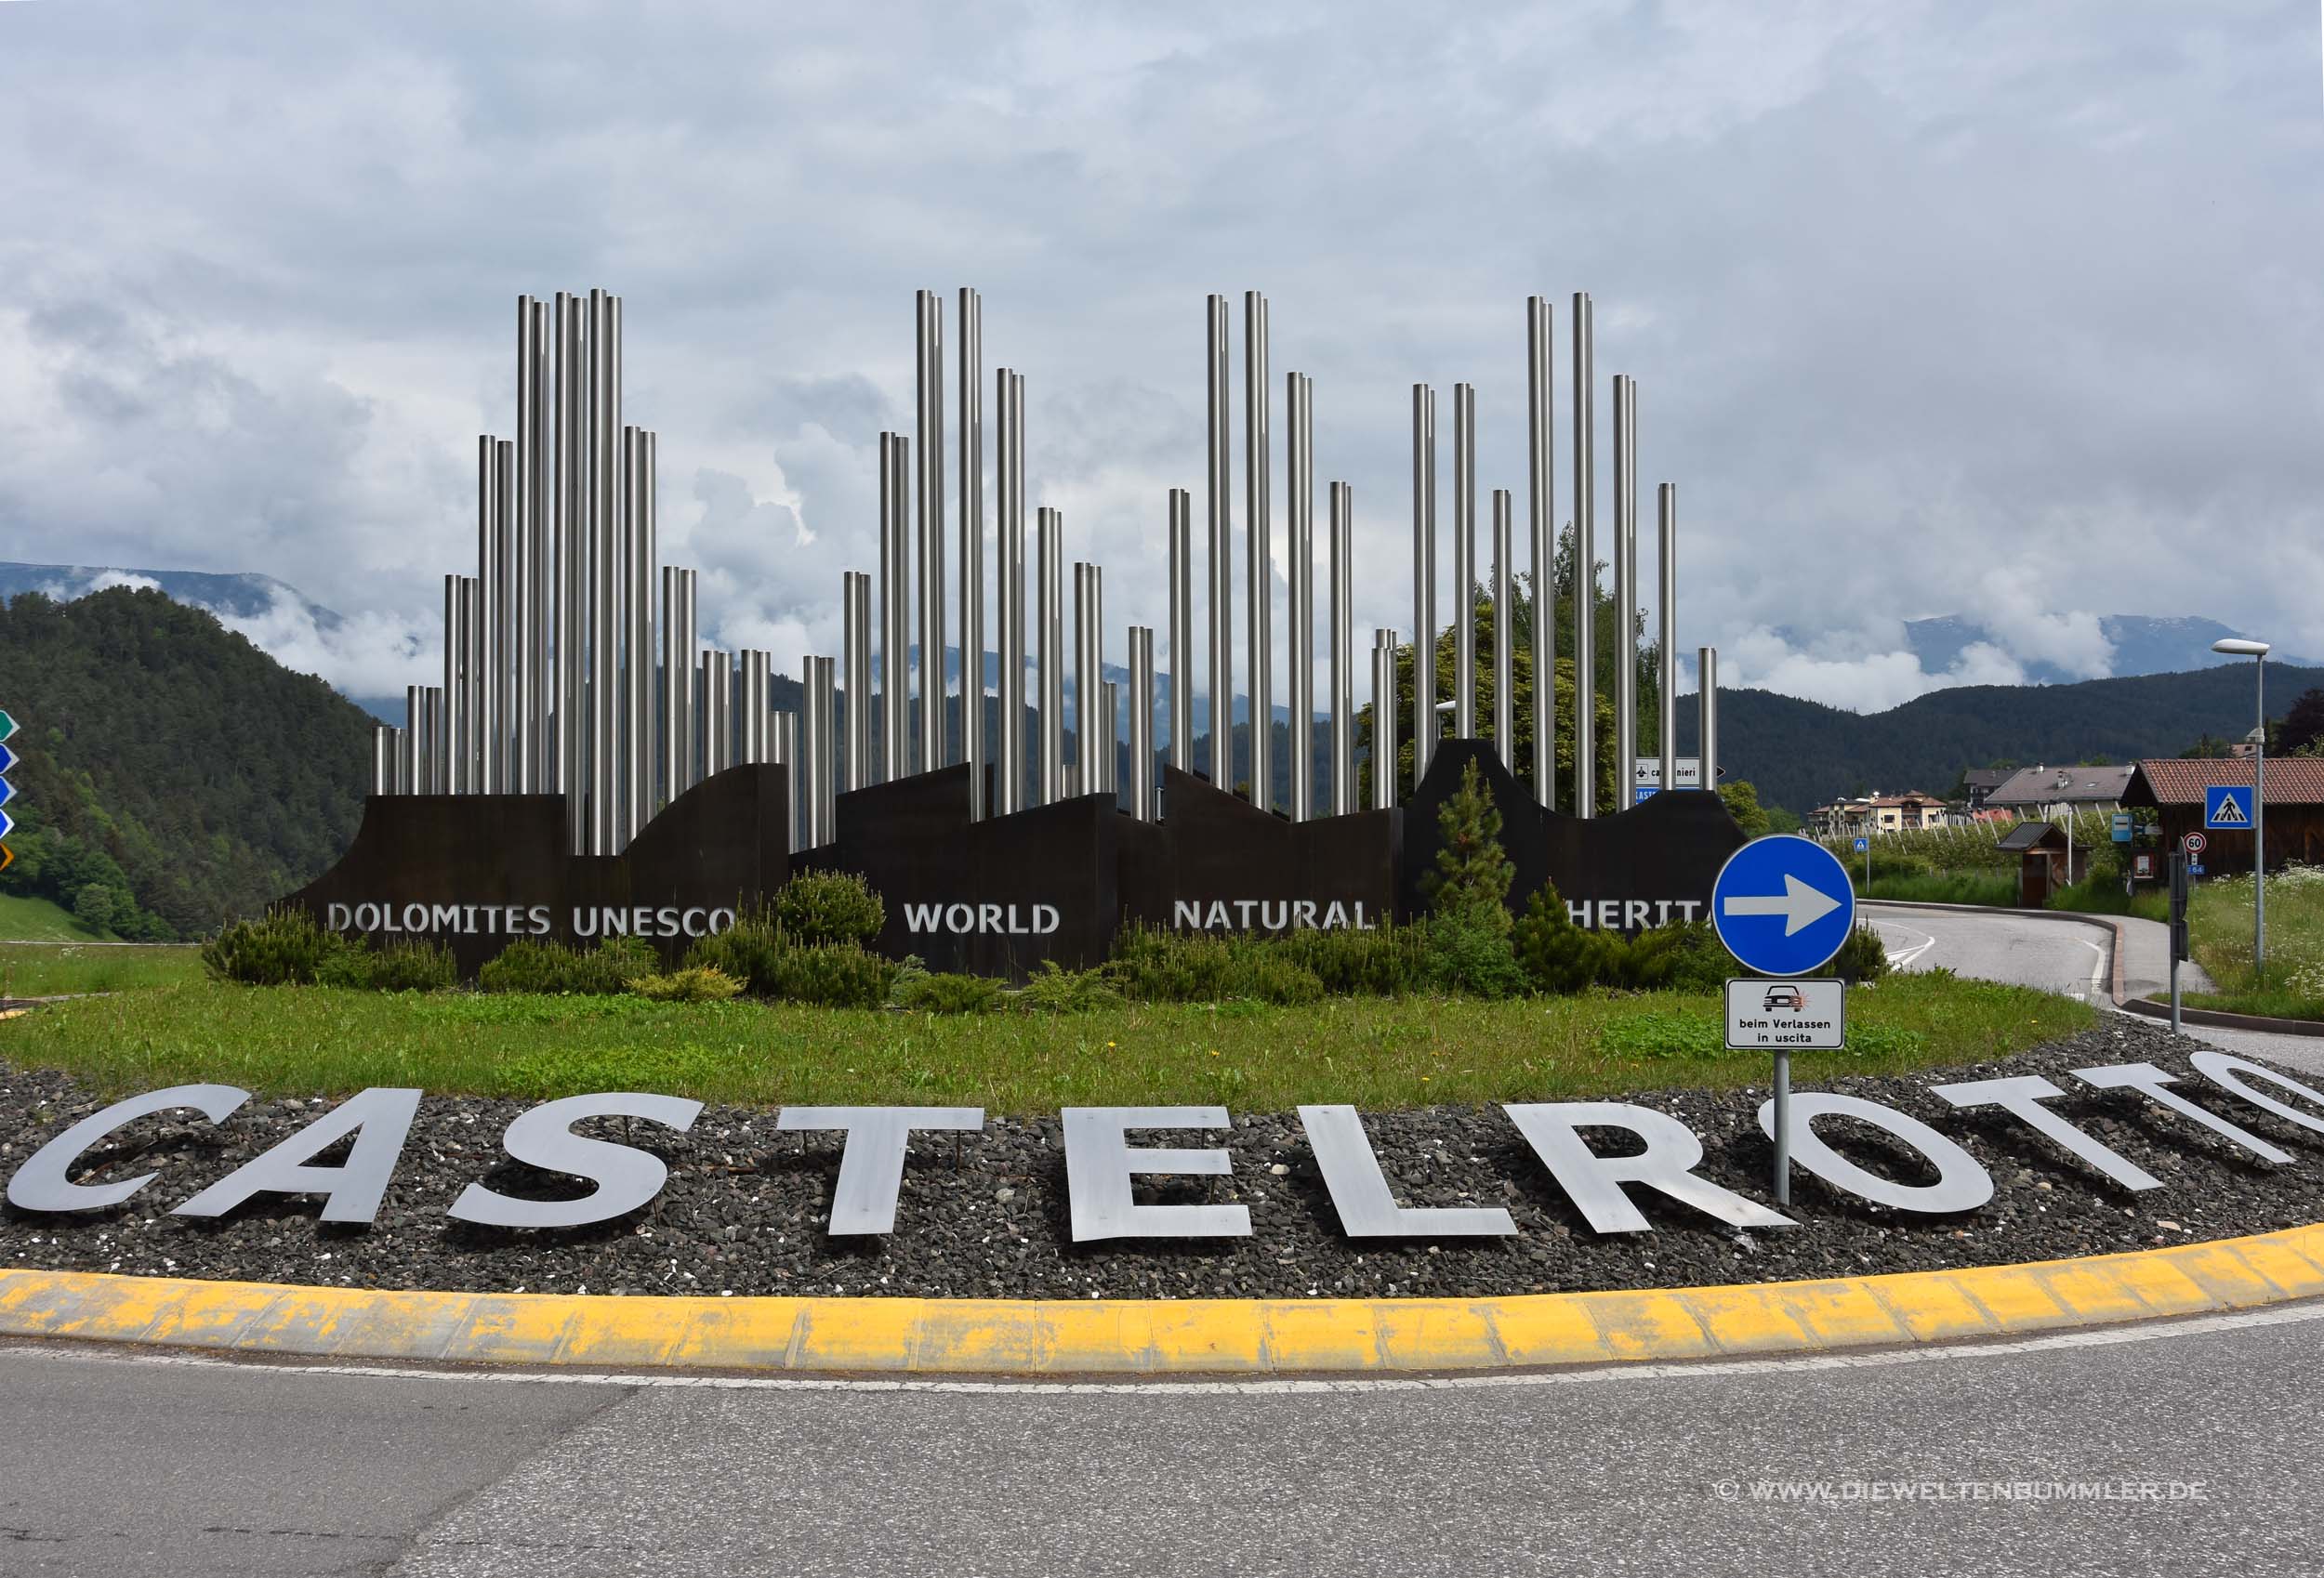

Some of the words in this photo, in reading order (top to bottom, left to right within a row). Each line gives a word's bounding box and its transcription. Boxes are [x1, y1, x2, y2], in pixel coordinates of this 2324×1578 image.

[2188, 837, 2201, 848] 60
[328, 902, 551, 934] DOLOMITES
[573, 906, 736, 937] UNESCO
[904, 903, 1060, 934] WORLD
[1174, 900, 1376, 930] NATURAL
[1566, 899, 1712, 930] HERIT
[1739, 1019, 1768, 1029] beim
[1773, 1019, 1830, 1029] Verlassen
[1758, 1033, 1768, 1042] in
[1776, 1033, 1812, 1043] uscita
[7, 1050, 2324, 1243] CASTELROTTO
